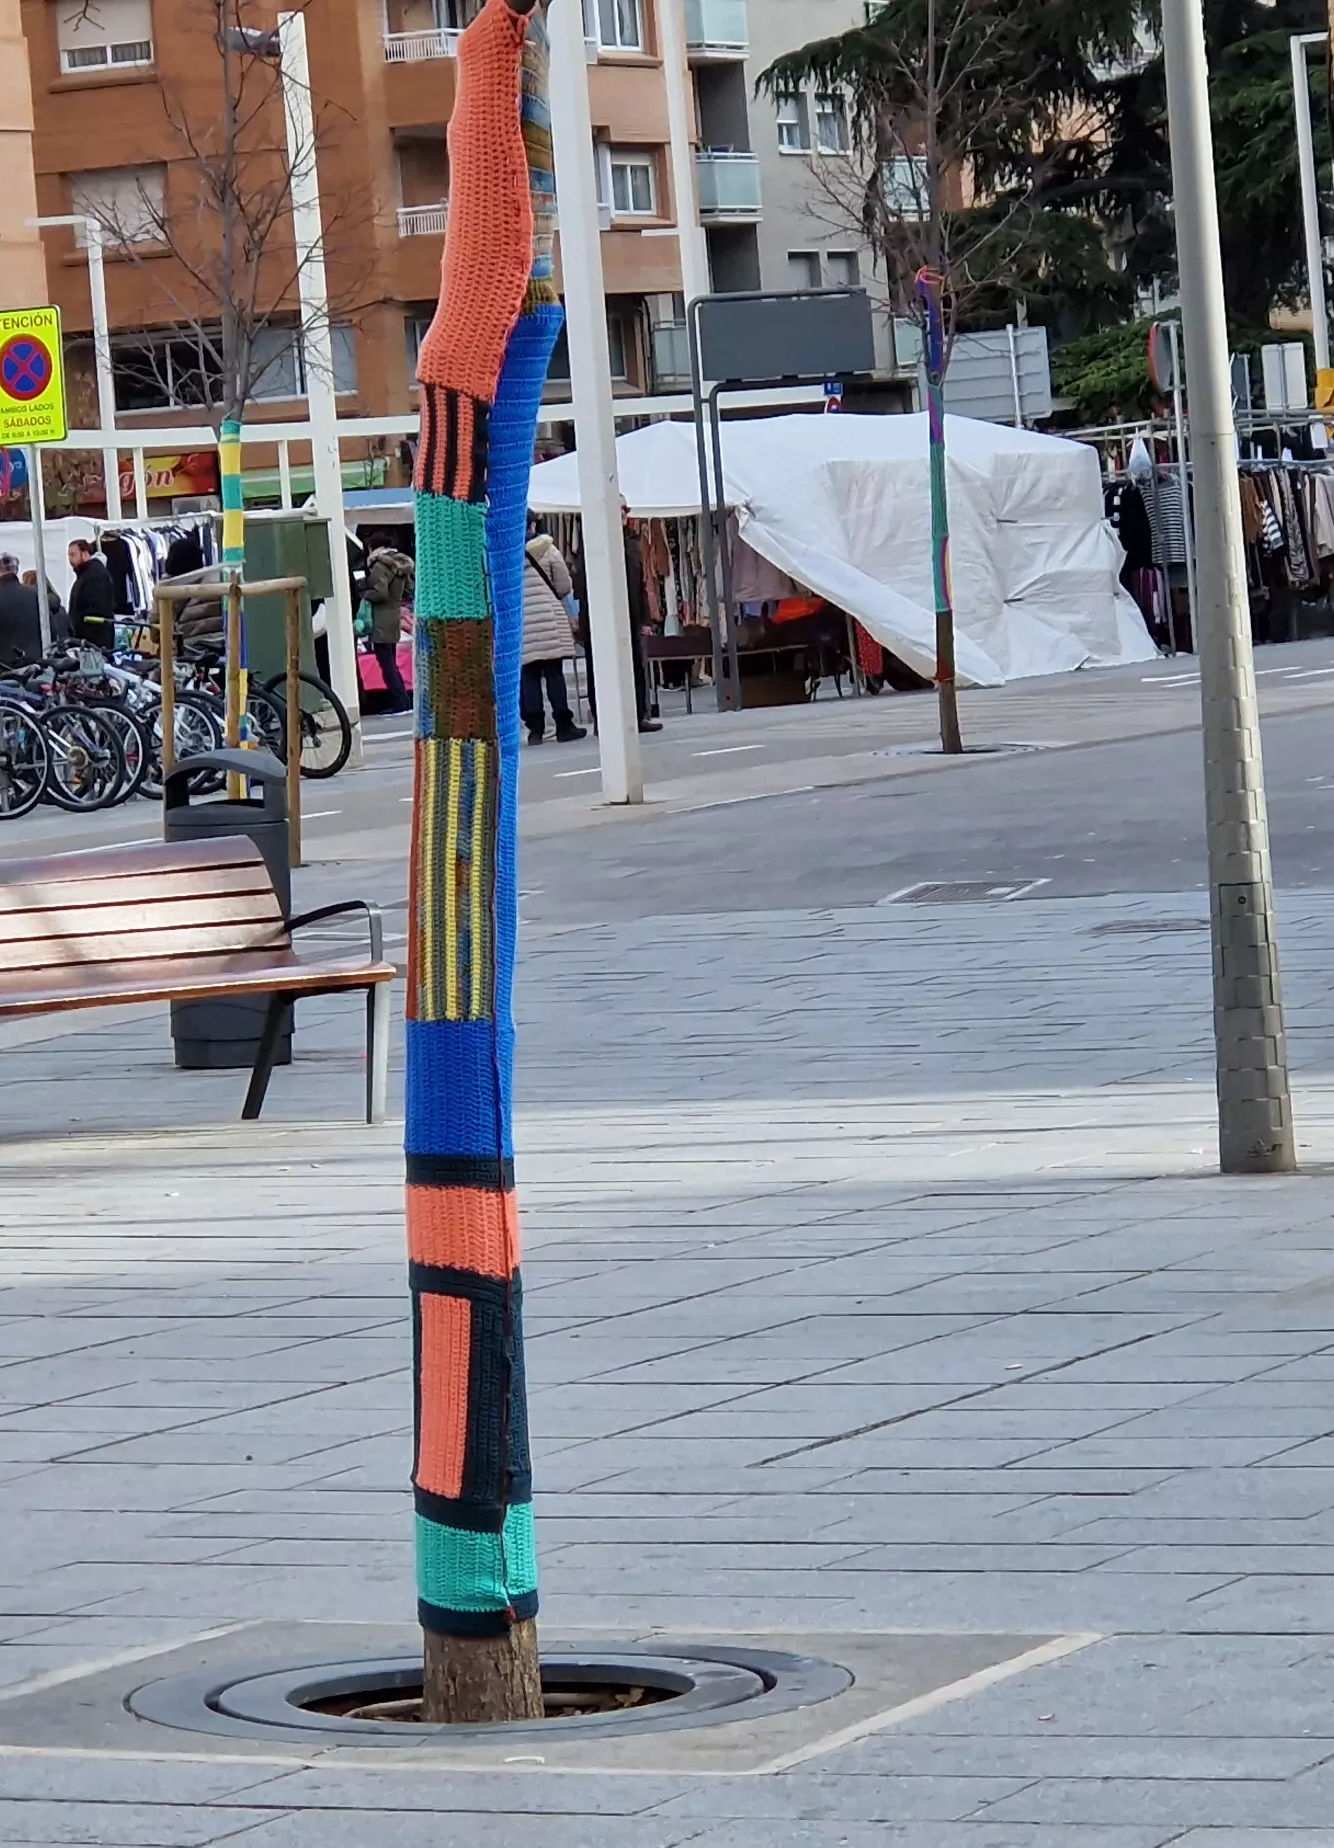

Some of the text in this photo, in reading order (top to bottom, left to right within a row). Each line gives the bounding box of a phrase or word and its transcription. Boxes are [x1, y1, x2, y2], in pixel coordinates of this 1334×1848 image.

[0, 402, 55, 414] AMBOS LADOS
[3, 415, 52, 429] SÁBADOS
